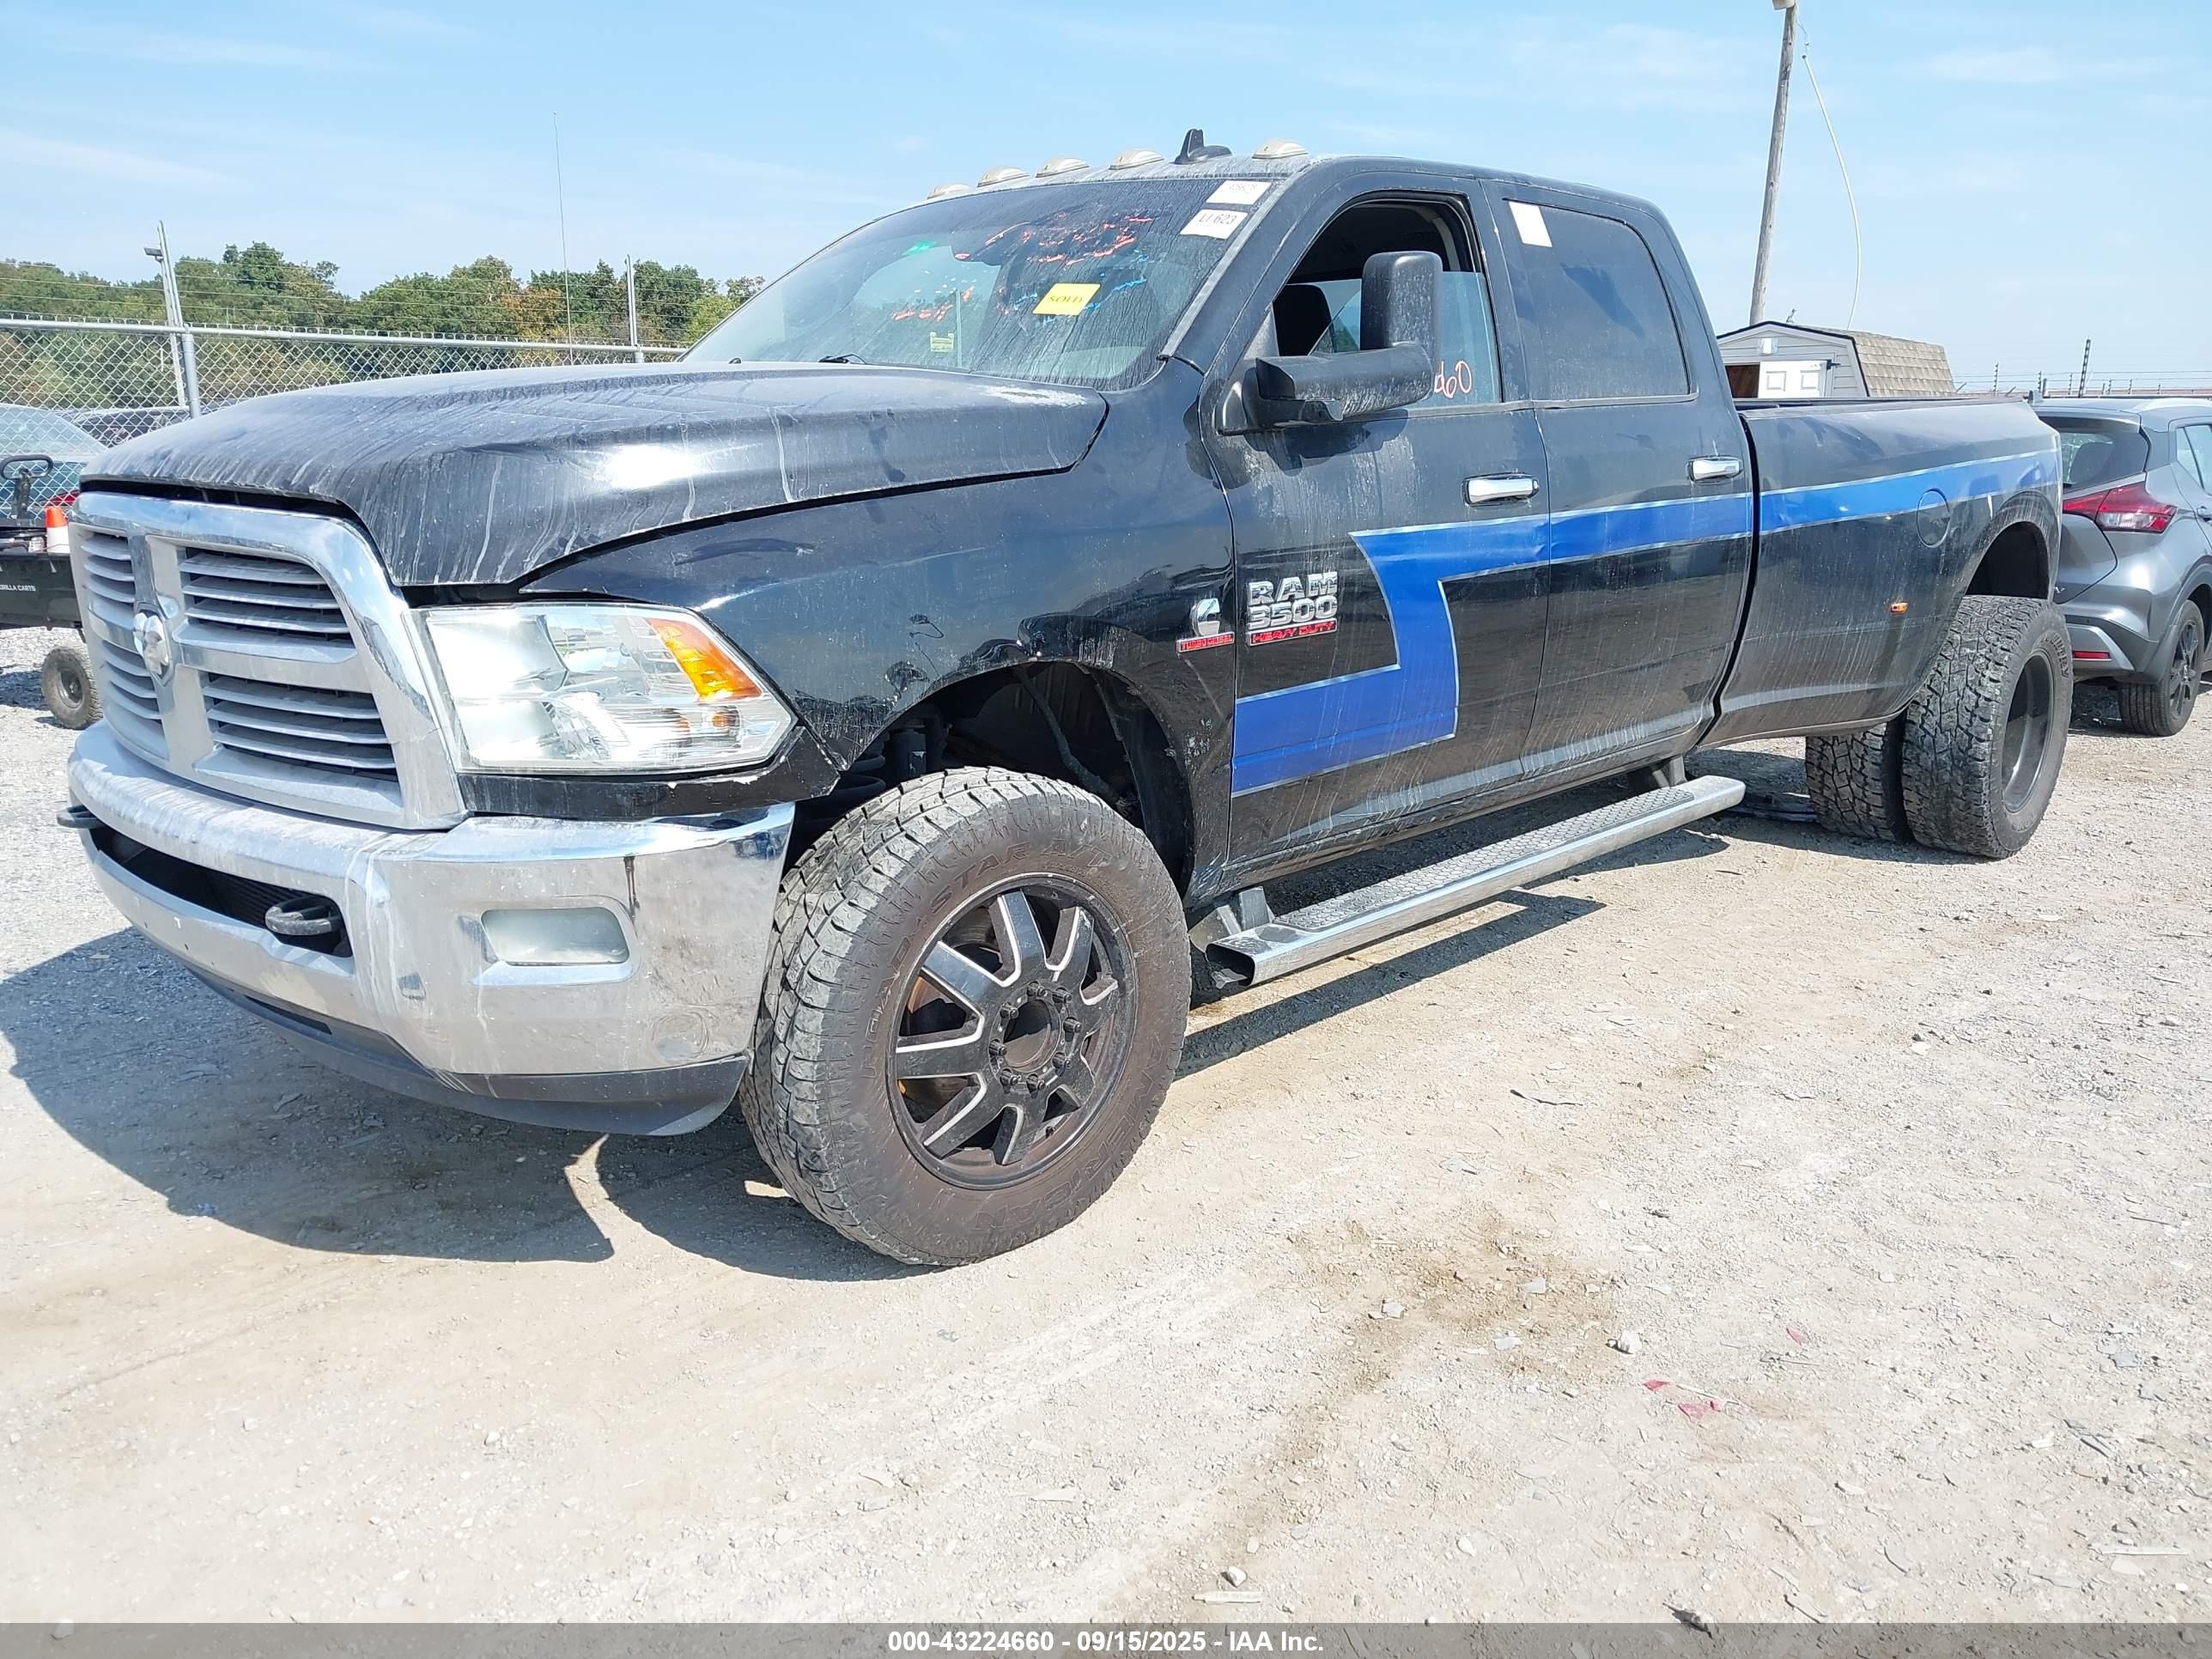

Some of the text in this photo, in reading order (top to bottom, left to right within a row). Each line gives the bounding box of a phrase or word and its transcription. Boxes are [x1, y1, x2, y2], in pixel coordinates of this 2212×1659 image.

[17, 584, 36, 592] CARTS
[1248, 571, 1338, 606] RAM
[1247, 594, 1338, 630] 3500
[1181, 634, 1233, 650] TURBO DIESEL
[1252, 621, 1335, 643] HEAVY DUTY
